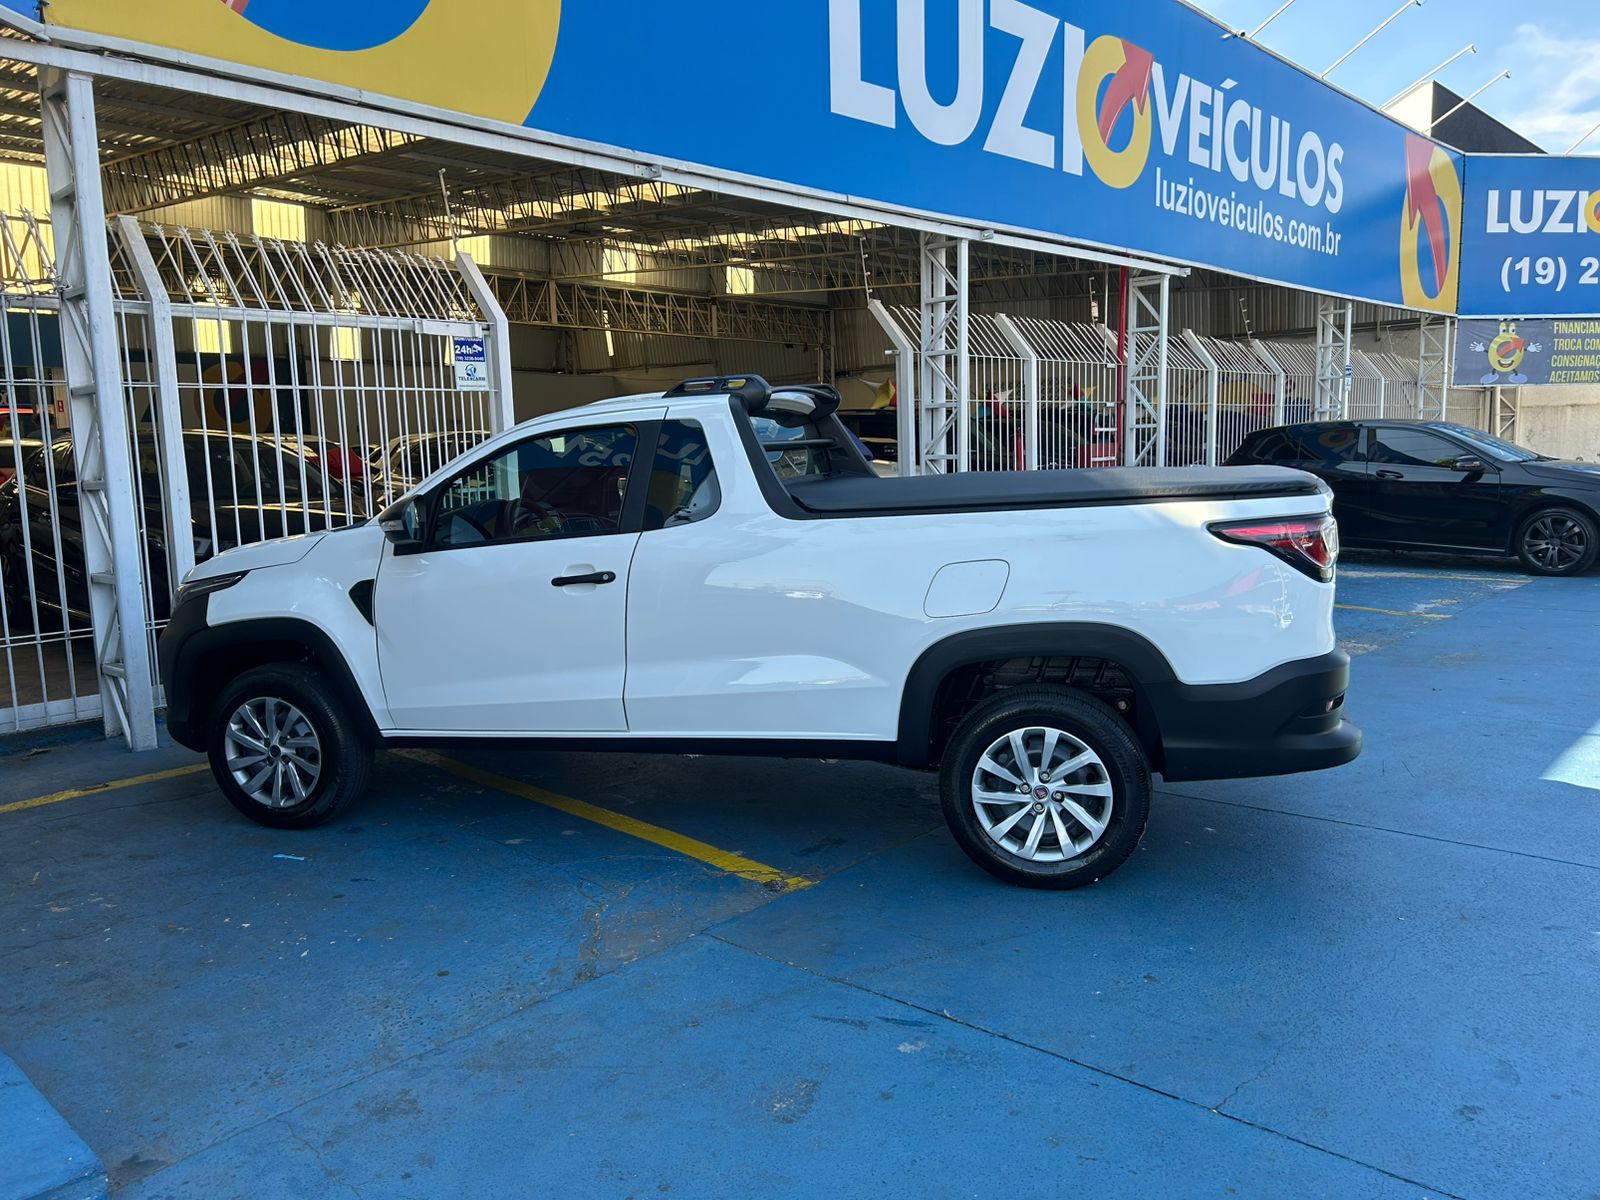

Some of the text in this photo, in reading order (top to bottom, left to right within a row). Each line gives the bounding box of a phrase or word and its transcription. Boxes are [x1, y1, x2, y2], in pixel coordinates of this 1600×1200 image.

[1151, 61, 1344, 214] VEÍCULOS
[1155, 166, 1341, 256] luzioveiculos.com.br
[1501, 256, 1600, 292] (19) 2
[454, 345, 472, 354] 24h
[1553, 338, 1582, 351] TROCA
[1549, 370, 1600, 383] ACEITAMOS
